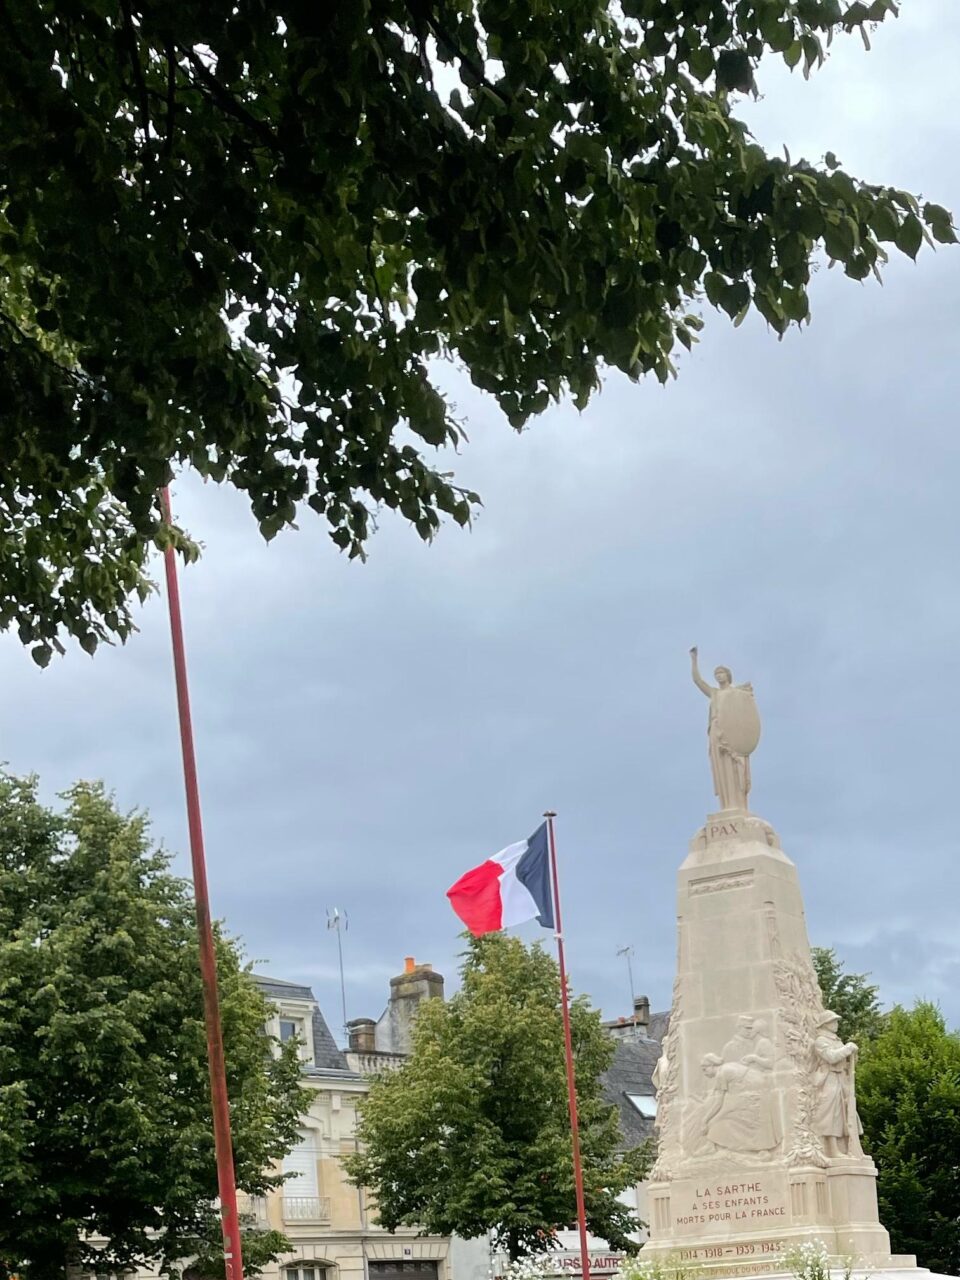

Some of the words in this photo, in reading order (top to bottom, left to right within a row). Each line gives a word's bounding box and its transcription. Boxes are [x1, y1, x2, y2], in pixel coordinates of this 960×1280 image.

[710, 823, 738, 837] PAX
[696, 1187, 711, 1198] LA
[716, 1182, 762, 1196] SARTHE
[702, 1200, 720, 1210] SES
[725, 1196, 769, 1208] ENFANTS
[676, 1215, 705, 1225] MORTS
[708, 1212, 731, 1223] POUR
[735, 1210, 747, 1220] LA
[751, 1206, 786, 1218] FRANCE
[704, 1247, 723, 1258] 1918
[735, 1244, 755, 1256] 1939
[761, 1242, 781, 1253] 1945
[751, 1263, 771, 1273] NORD
